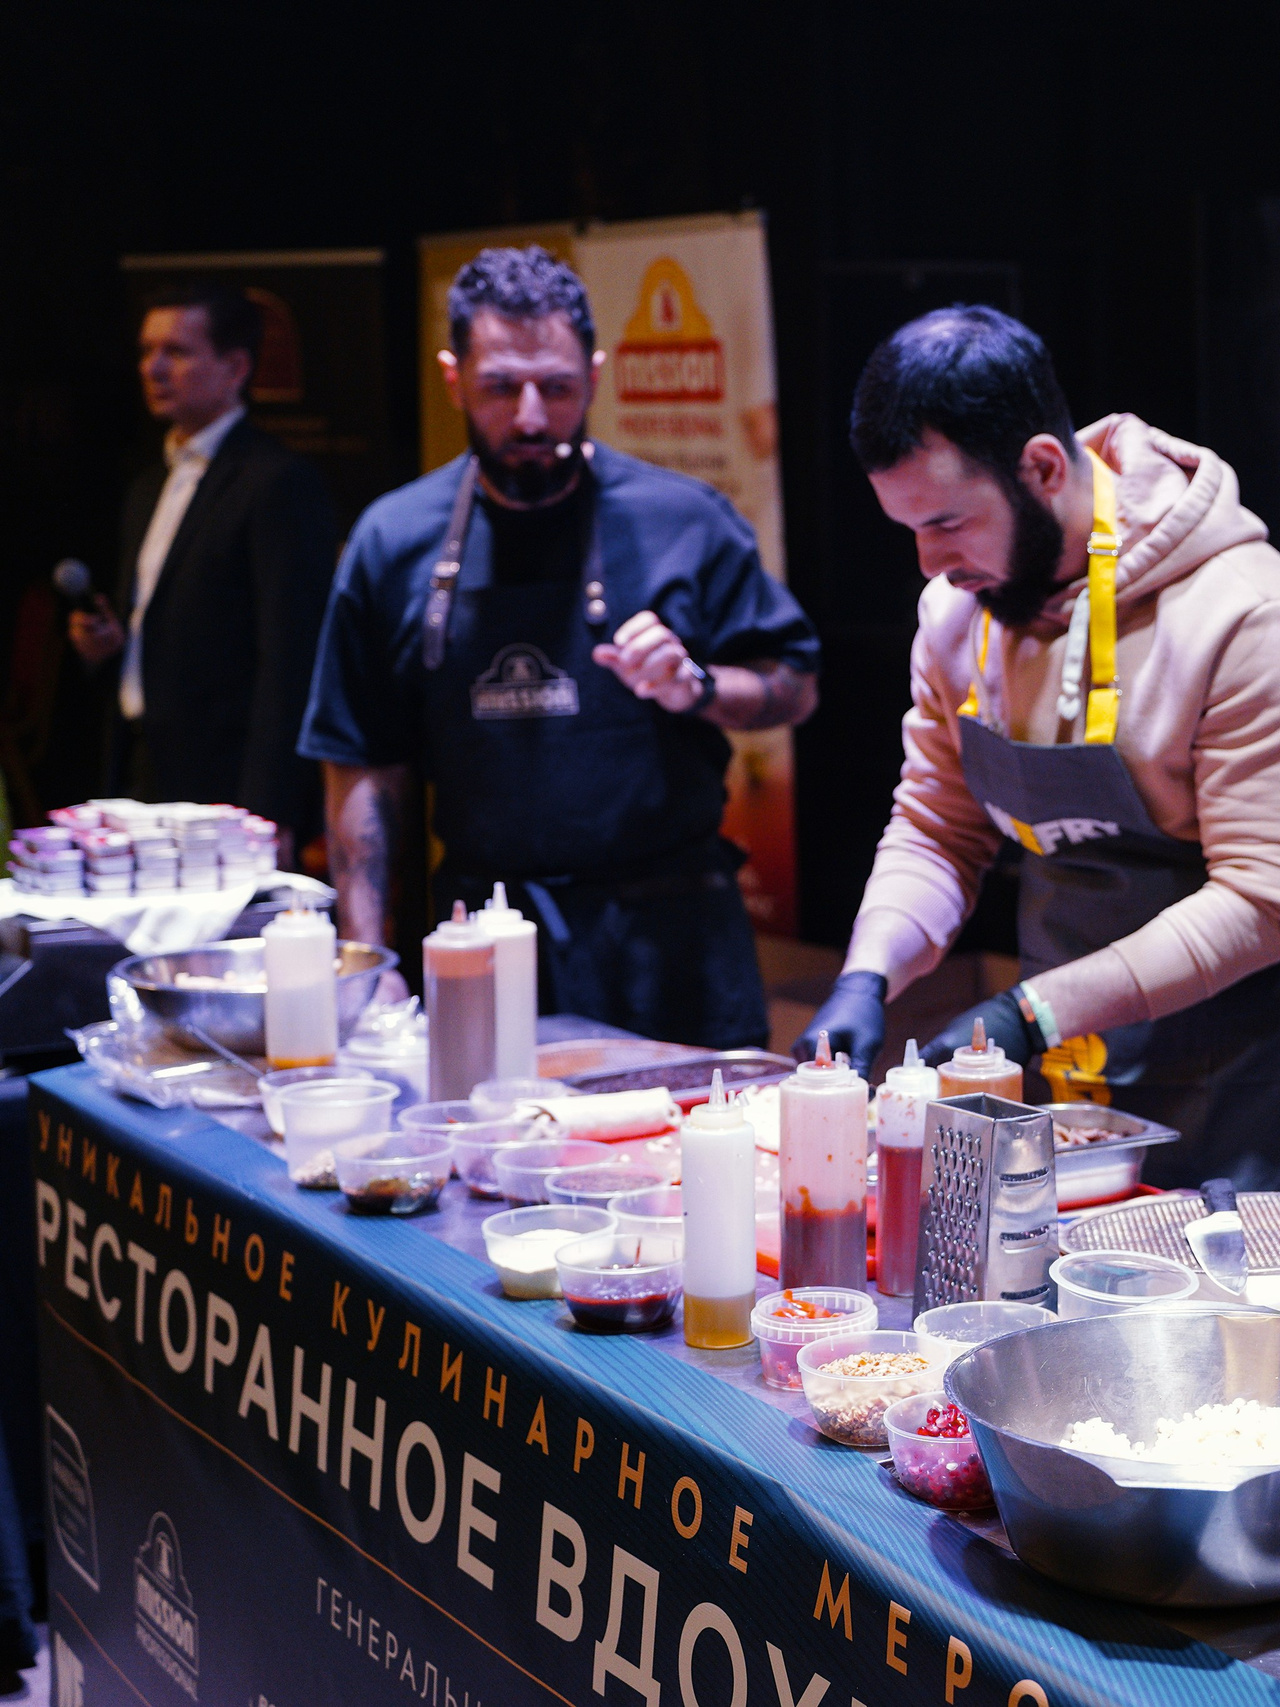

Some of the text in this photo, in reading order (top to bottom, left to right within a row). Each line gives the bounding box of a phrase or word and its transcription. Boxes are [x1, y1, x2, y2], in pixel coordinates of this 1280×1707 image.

[34, 1176, 501, 1592] РЕСТОРАННОЕ
[37, 1109, 296, 1302] УНИКАЛЬНОЕ
[331, 1280, 754, 1575] КУЛИНАРНОЕ
[315, 1575, 483, 1707] ГЕНЕРАЛЬ
